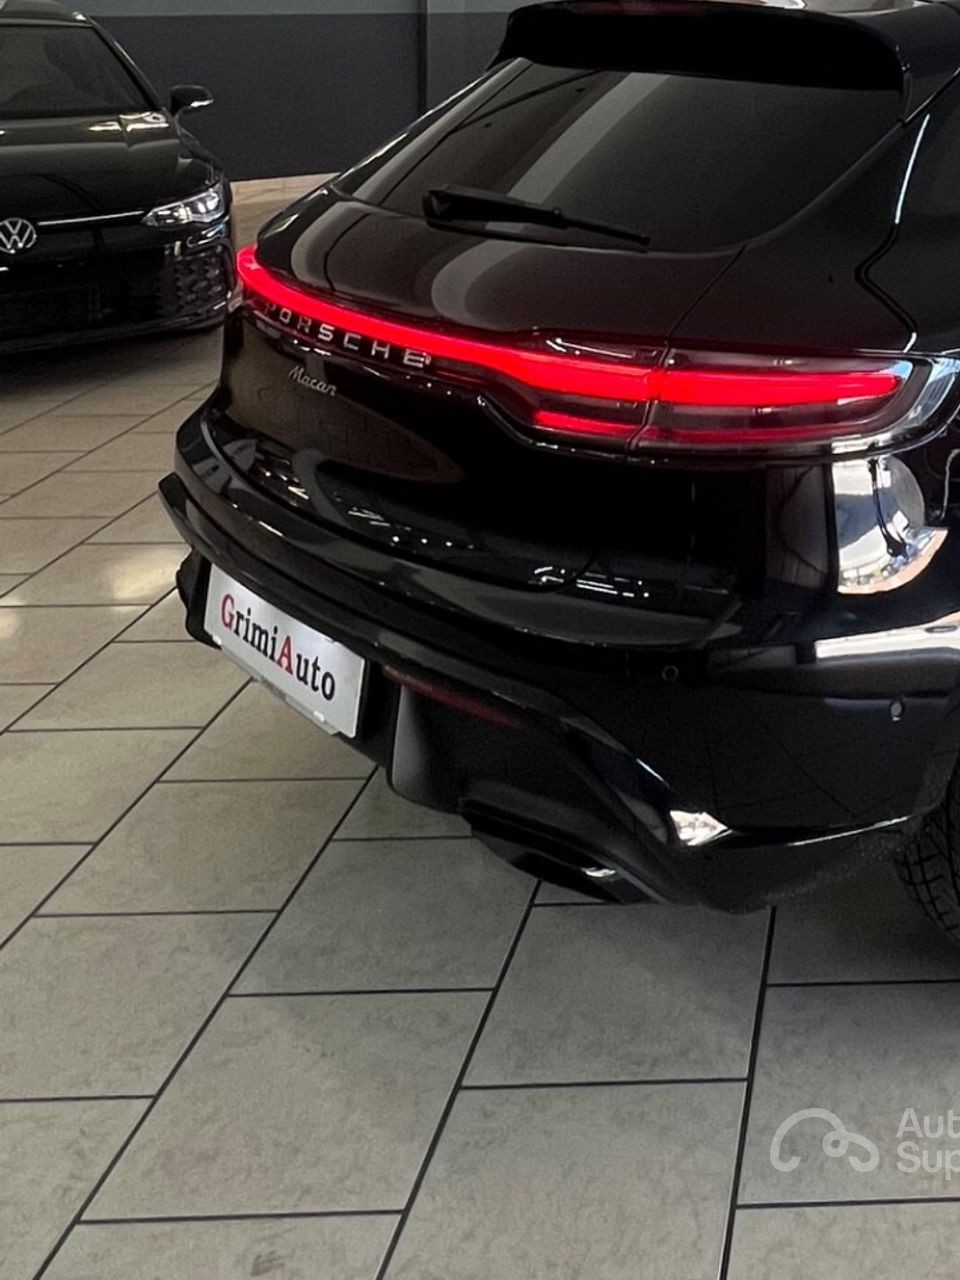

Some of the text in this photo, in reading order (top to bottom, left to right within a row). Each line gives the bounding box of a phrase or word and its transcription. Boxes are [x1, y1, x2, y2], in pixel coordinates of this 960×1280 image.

[265, 301, 425, 369] PORSCHE
[288, 365, 338, 397] Macan
[220, 593, 336, 702] GrimiAuto
